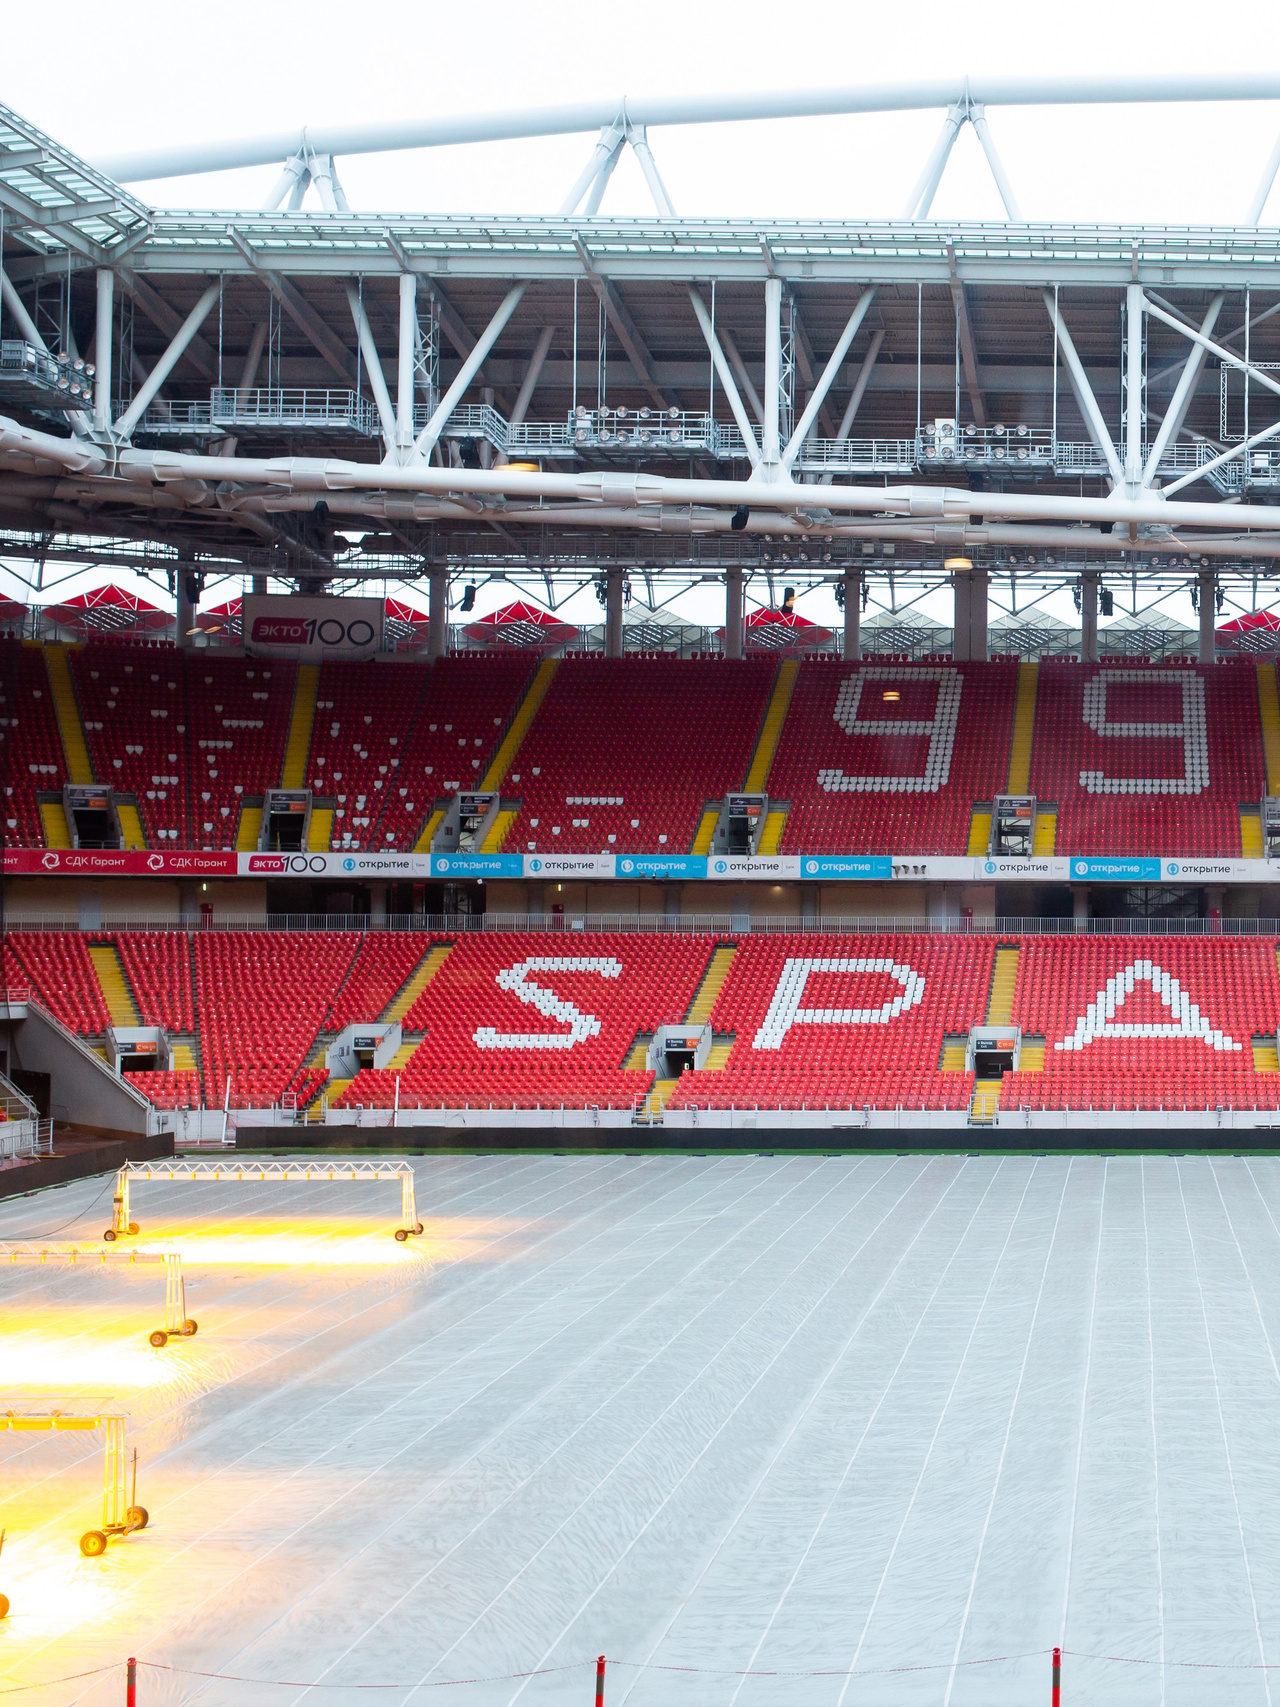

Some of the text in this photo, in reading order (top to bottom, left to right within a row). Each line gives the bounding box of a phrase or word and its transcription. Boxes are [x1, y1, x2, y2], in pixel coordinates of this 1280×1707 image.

[65, 857, 126, 867] СДК Гарант
[170, 858, 227, 868] СДК Гарант
[359, 860, 409, 870] открытие
[452, 860, 501, 870] открытие
[545, 860, 594, 870] открытие
[636, 862, 686, 872] открытие
[730, 862, 779, 872] открытие
[821, 862, 870, 872] открытие
[1000, 863, 1048, 873] открытие
[1091, 864, 1140, 874] открытие
[1182, 865, 1230, 874] открытие
